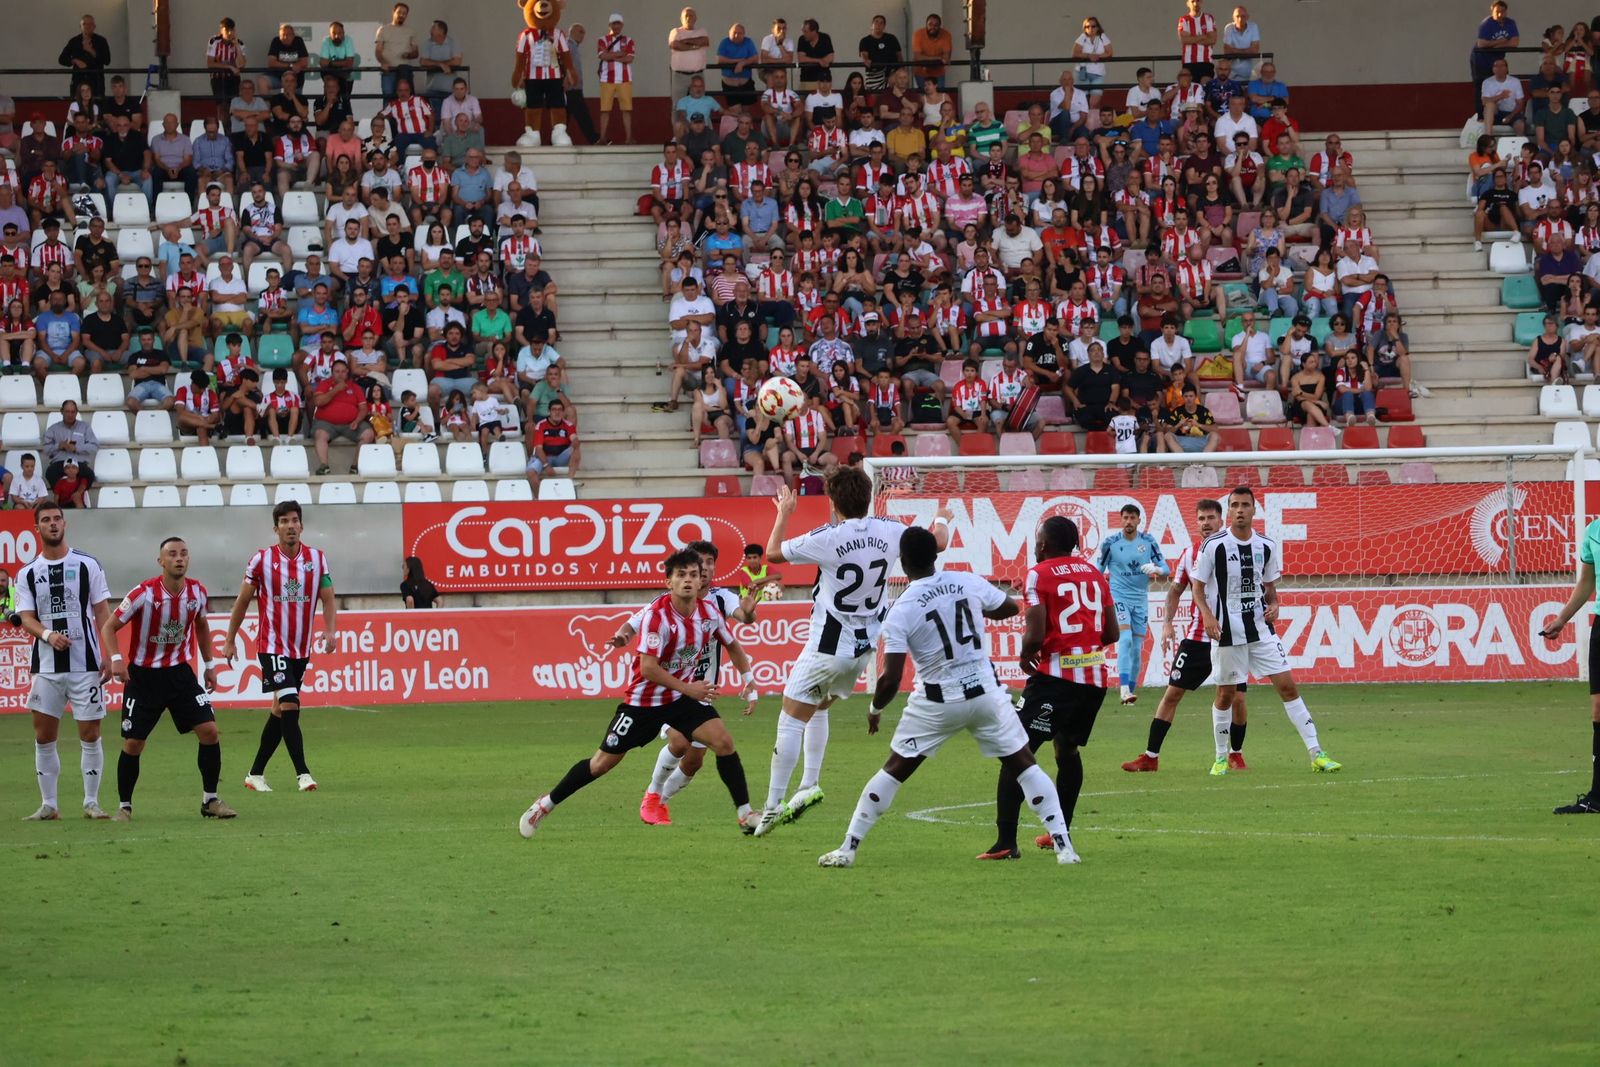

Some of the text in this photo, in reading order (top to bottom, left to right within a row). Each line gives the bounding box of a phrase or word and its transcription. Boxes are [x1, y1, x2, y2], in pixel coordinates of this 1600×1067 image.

[446, 562, 579, 578] EMBUTIDOS
[590, 562, 598, 574] Y
[833, 558, 888, 612] 23
[917, 583, 964, 608] JANNICK
[1057, 580, 1103, 635] 24
[380, 622, 459, 653] Joven
[925, 597, 982, 660] 14
[1175, 652, 1188, 669] 6
[1277, 642, 1285, 658] 9
[270, 654, 287, 672] 16
[401, 667, 417, 699] y
[424, 658, 489, 690] León
[89, 685, 103, 704] 21
[125, 697, 135, 717] 4
[612, 712, 634, 736] 18
